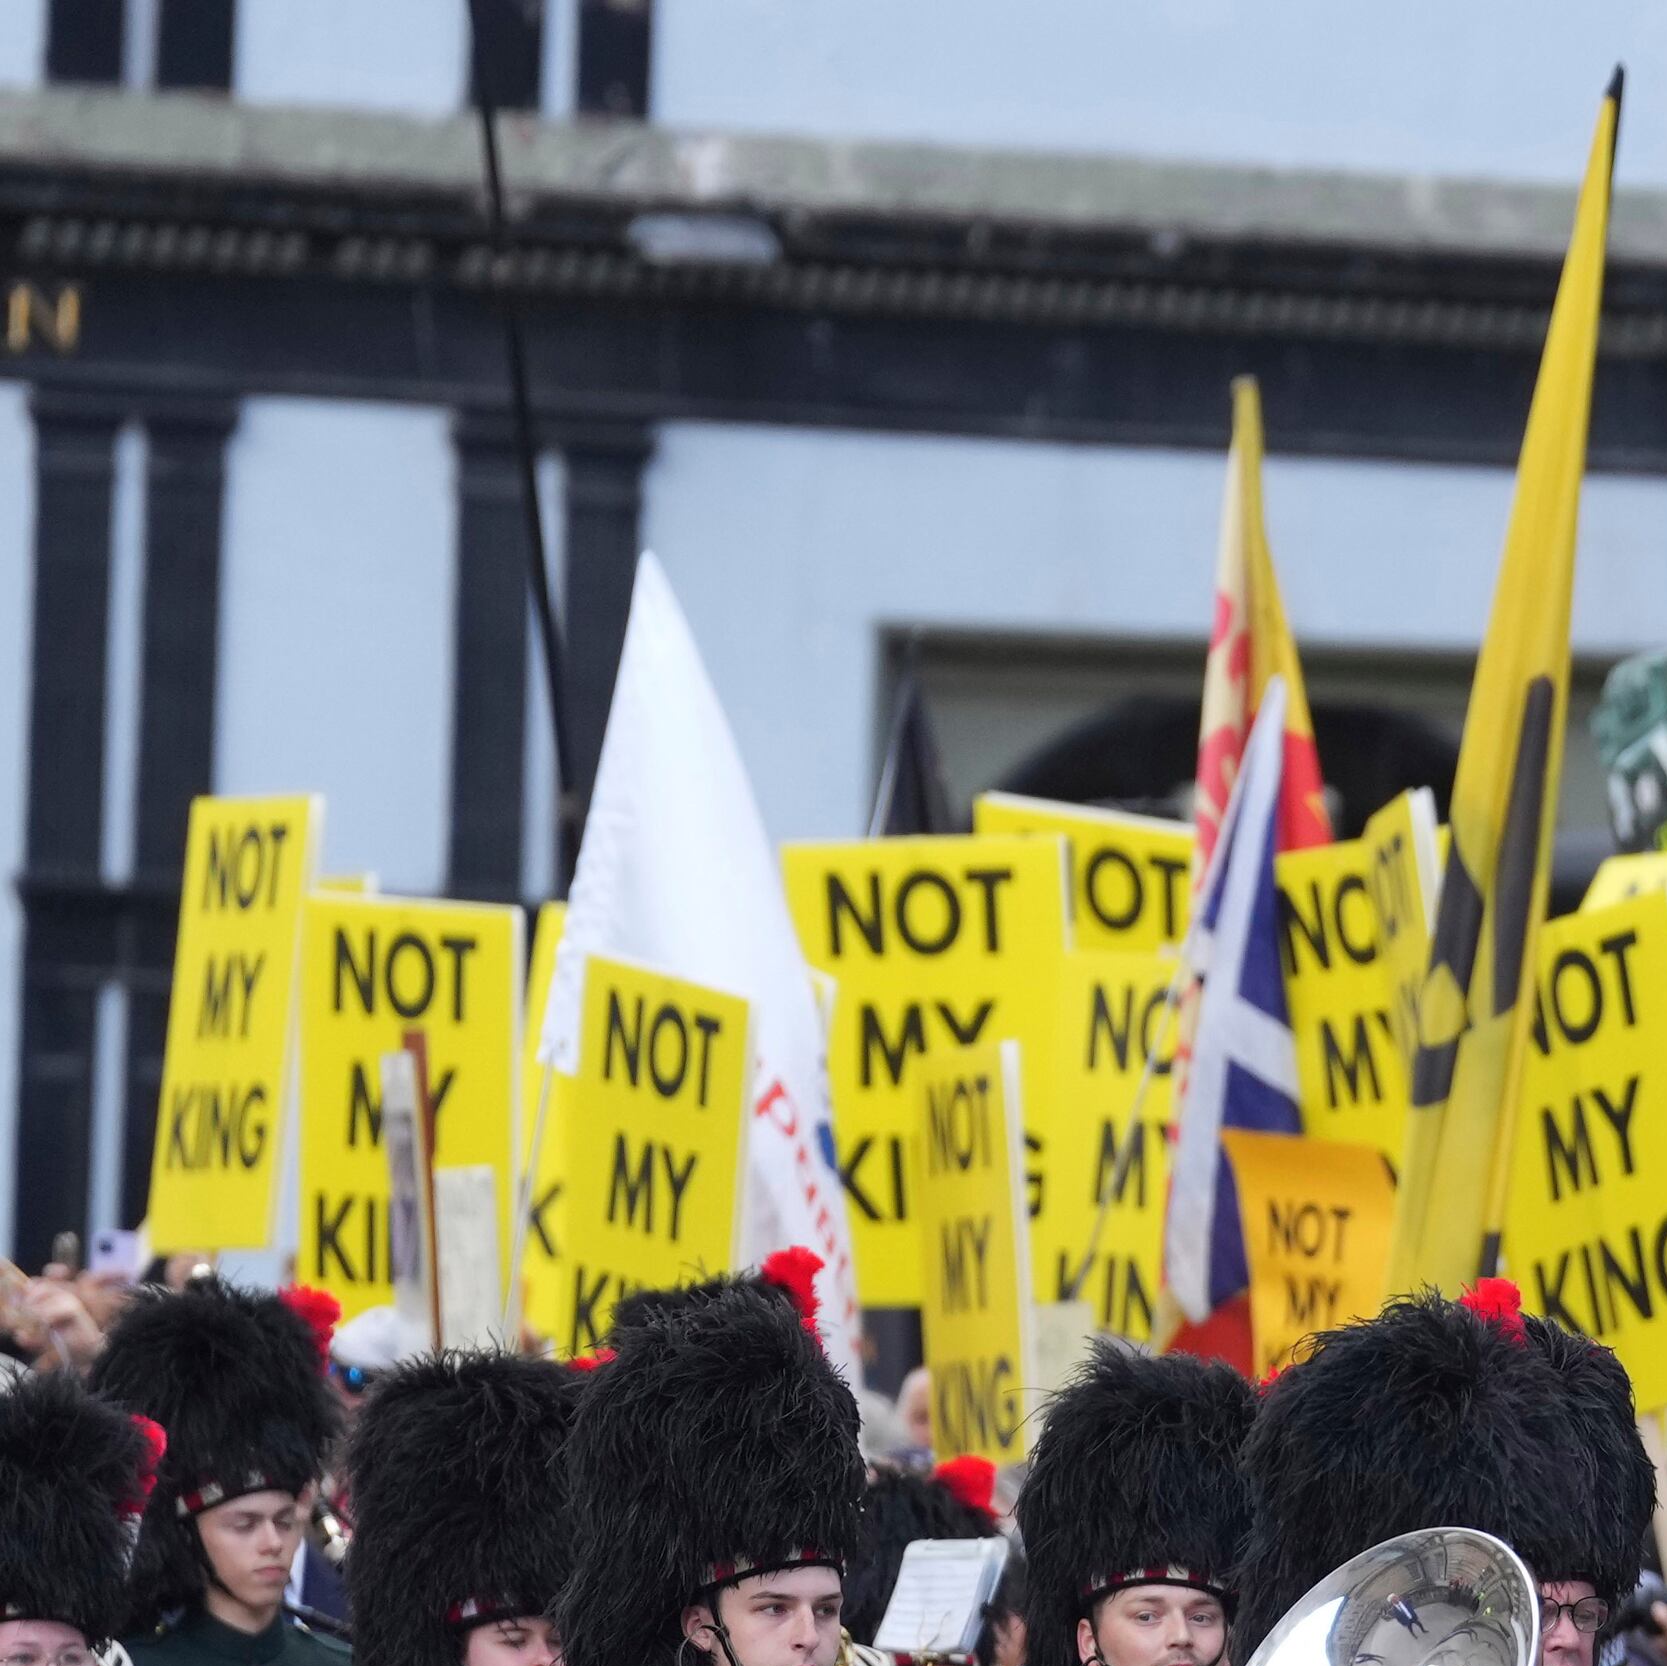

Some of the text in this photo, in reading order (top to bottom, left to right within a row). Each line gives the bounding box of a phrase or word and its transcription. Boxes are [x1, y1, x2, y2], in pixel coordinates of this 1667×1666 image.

[203, 823, 289, 912] NOT
[826, 868, 1011, 957] NOT
[1070, 848, 1189, 939] OT
[1281, 873, 1378, 976] NO
[198, 953, 266, 1041] MY
[332, 926, 478, 1022] NOT
[605, 988, 722, 1108] NOT
[1087, 983, 1180, 1076] NO
[167, 1082, 269, 1174] KING
[926, 1074, 992, 1176] NOT
[1540, 1075, 1641, 1204] MY
[607, 1132, 698, 1244] MY
[1267, 1199, 1352, 1264] NOT
[940, 1217, 992, 1313] MY
[1284, 1274, 1341, 1328] MY
[936, 1356, 1014, 1450] KING
